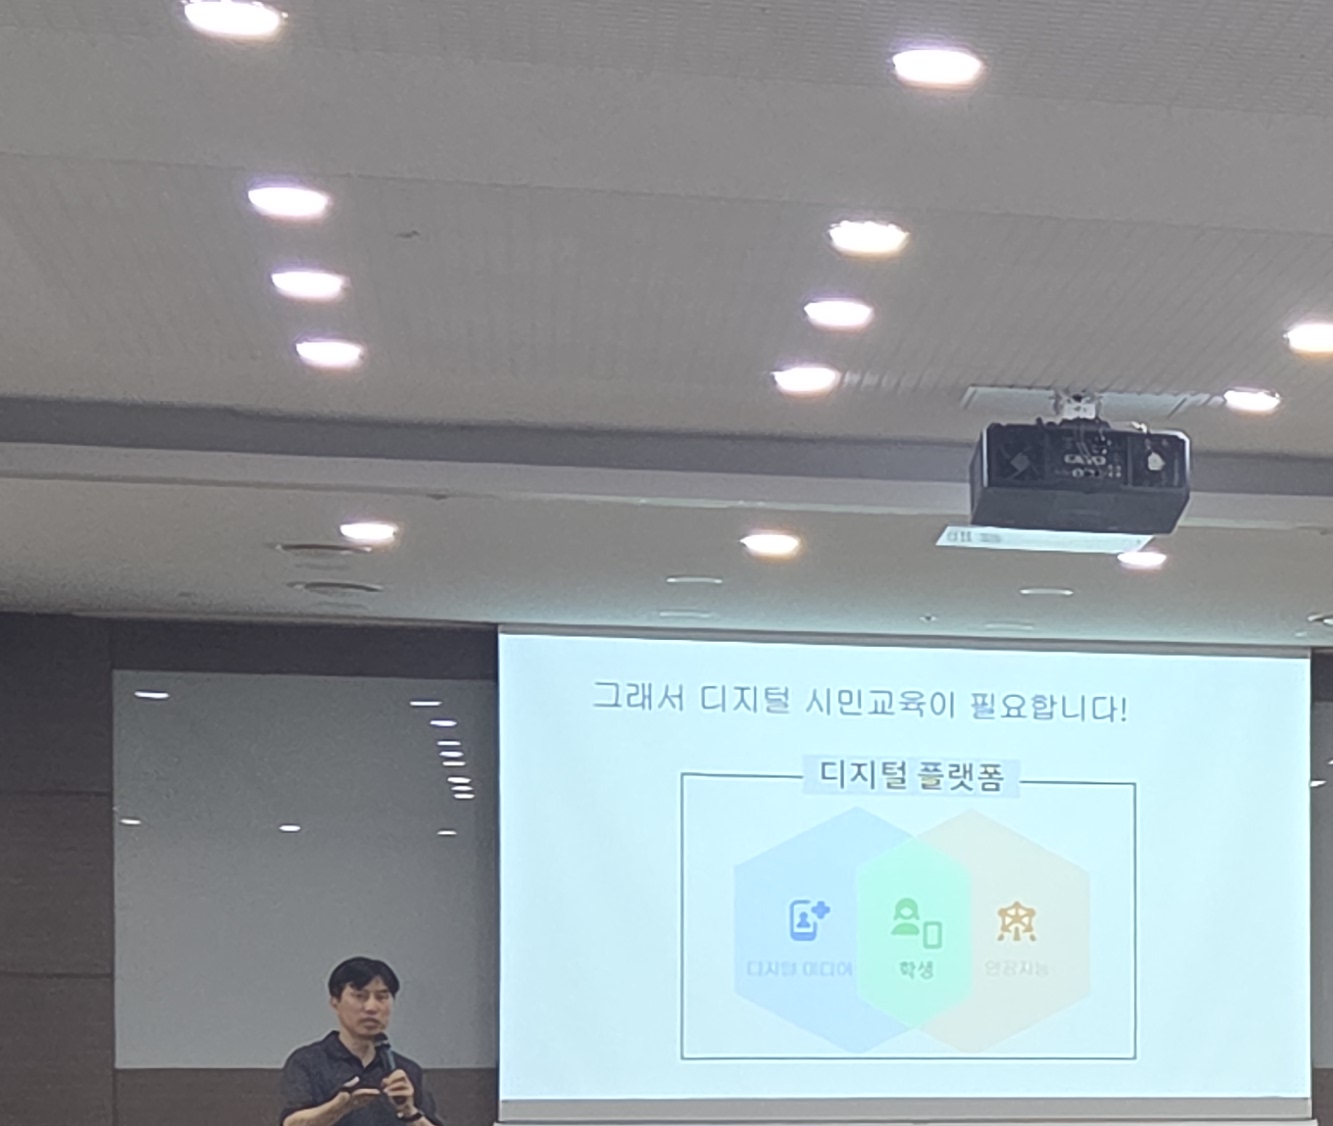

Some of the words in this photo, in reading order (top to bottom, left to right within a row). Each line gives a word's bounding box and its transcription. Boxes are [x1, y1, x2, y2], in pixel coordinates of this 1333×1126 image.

[593, 681, 684, 712] 그래서
[701, 685, 790, 714] 디지털
[805, 687, 955, 718] 시민교육이
[970, 691, 1127, 722] 필요합니다!
[820, 760, 906, 791] 디지털
[918, 761, 1004, 792] 플랫폼
[899, 961, 934, 979] 학생
